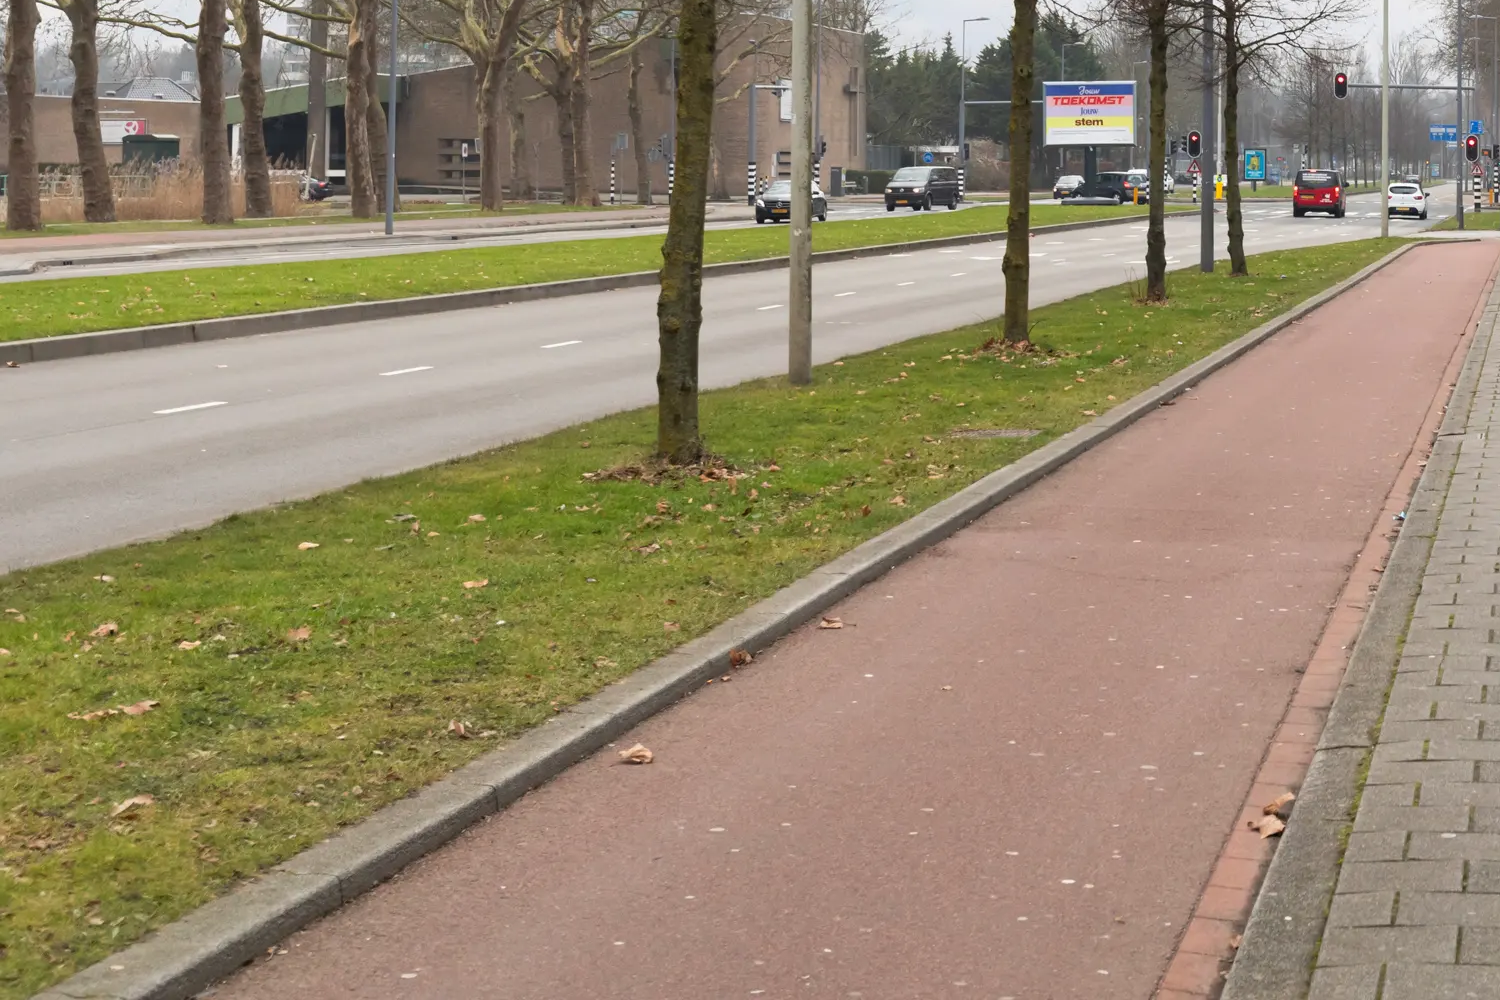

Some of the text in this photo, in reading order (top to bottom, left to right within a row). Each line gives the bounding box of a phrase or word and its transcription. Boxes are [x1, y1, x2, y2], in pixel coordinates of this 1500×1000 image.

[1078, 85, 1100, 95] Jouw
[1053, 96, 1125, 106] TOEKOMST
[1080, 107, 1099, 116] Jouw
[1075, 118, 1103, 126] stem
